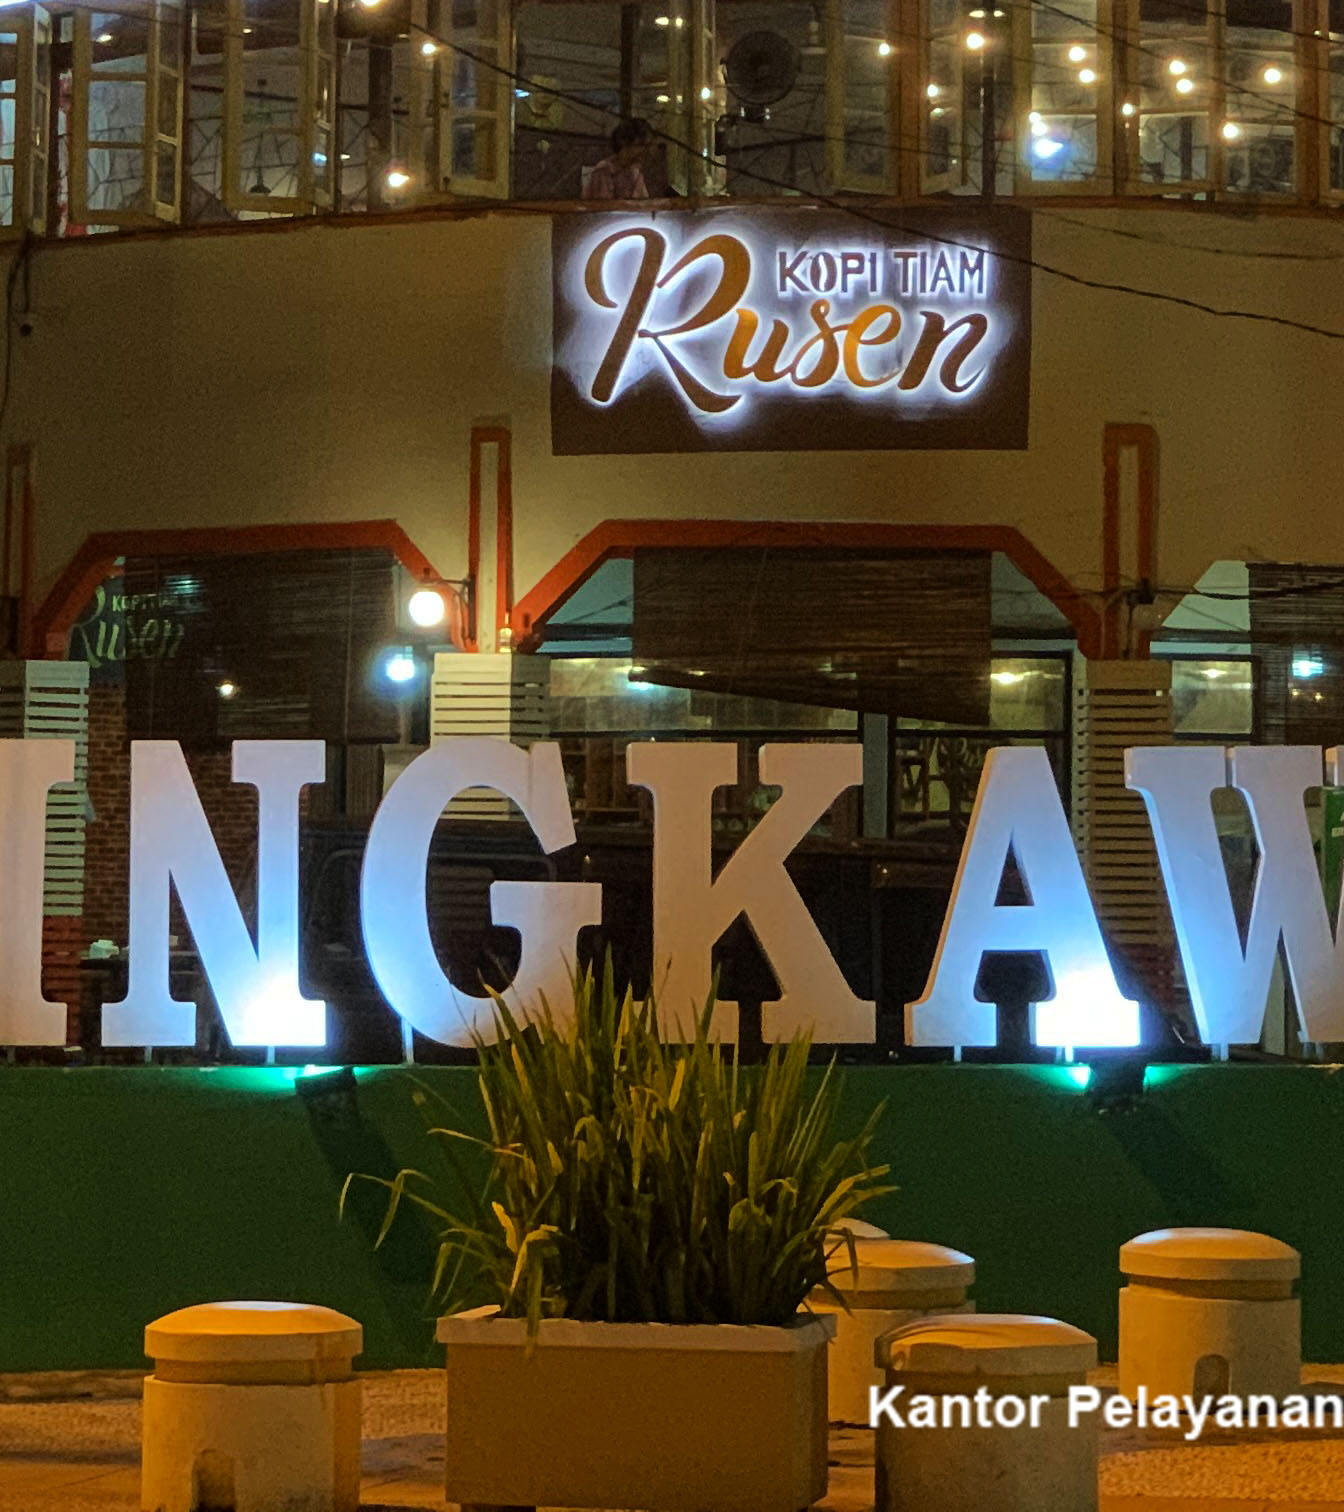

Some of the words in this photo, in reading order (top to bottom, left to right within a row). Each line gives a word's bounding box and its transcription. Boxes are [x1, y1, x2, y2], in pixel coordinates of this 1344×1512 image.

[583, 225, 988, 413] Rusen
[777, 249, 878, 294] KOPI
[893, 248, 987, 294] TIAM
